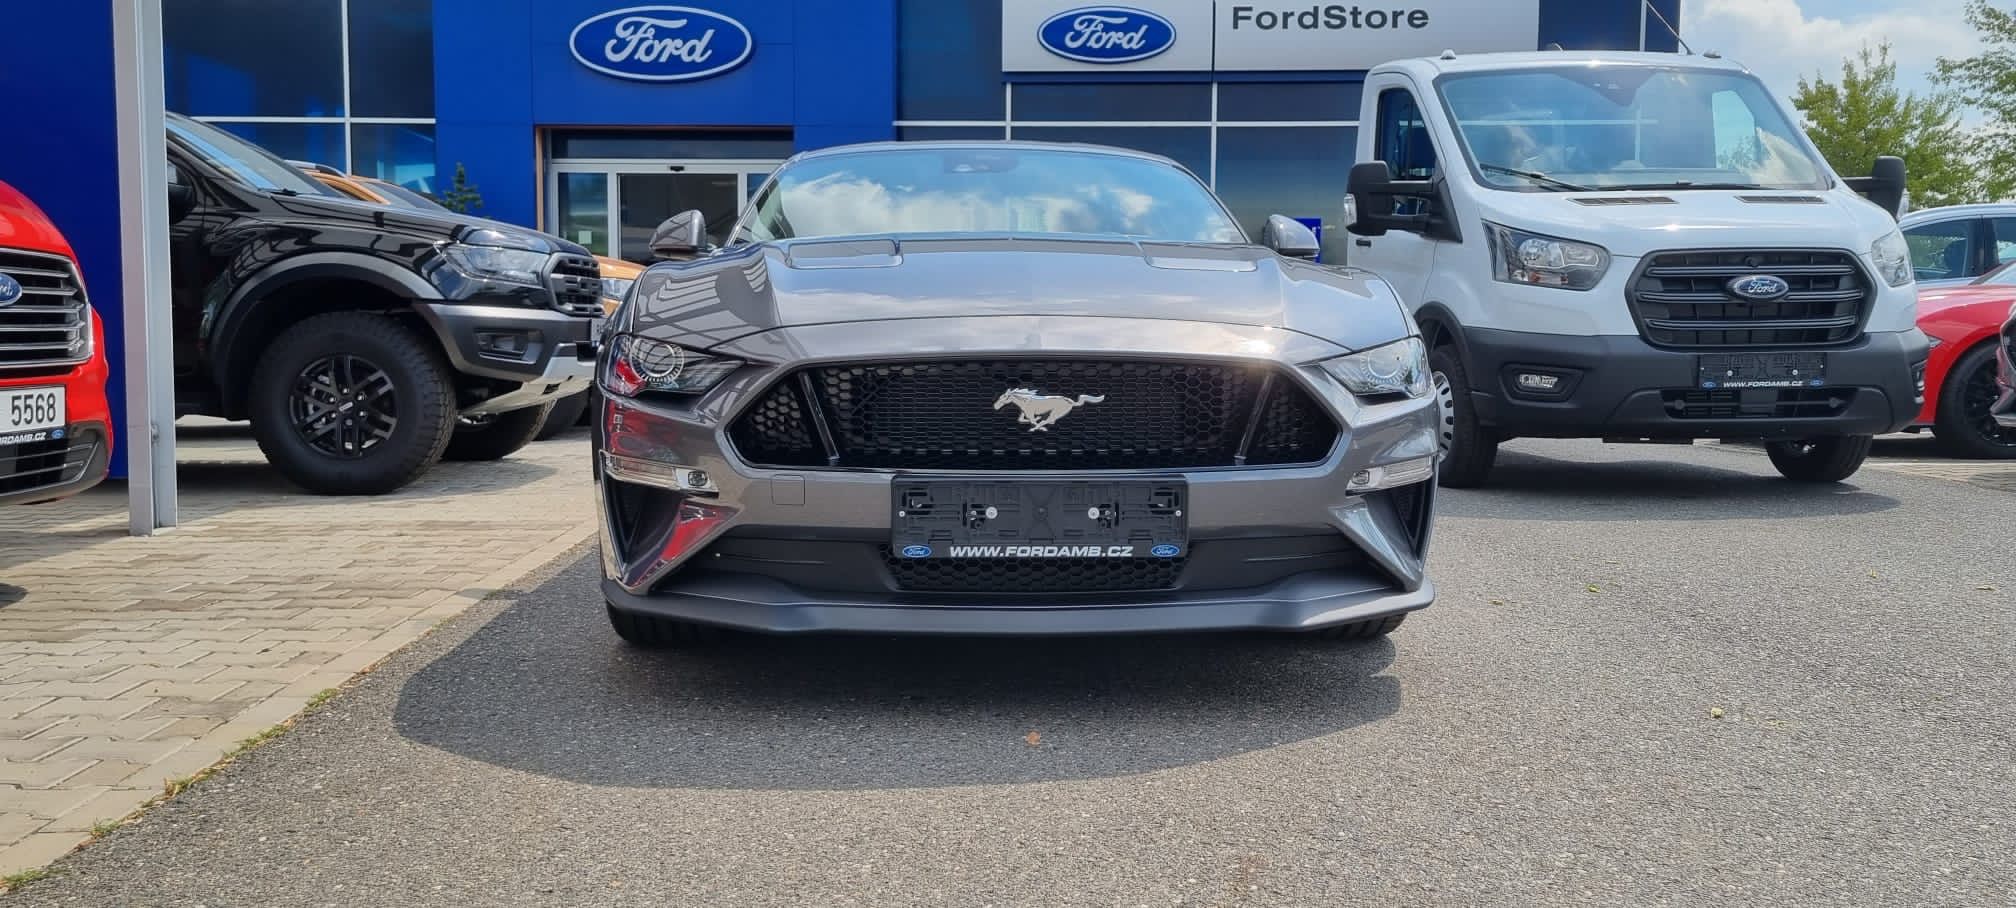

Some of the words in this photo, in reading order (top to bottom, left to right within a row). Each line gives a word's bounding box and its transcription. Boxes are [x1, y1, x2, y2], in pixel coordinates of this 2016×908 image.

[1232, 5, 1429, 30] FordStore
[605, 16, 715, 63] Ford
[1064, 14, 1148, 49] Ford
[1748, 280, 1777, 293] Ford
[11, 393, 56, 426] 5568
[0, 432, 47, 446] RDAMB.CZ
[949, 545, 1134, 558] WWW.FORDAMB.CZ
